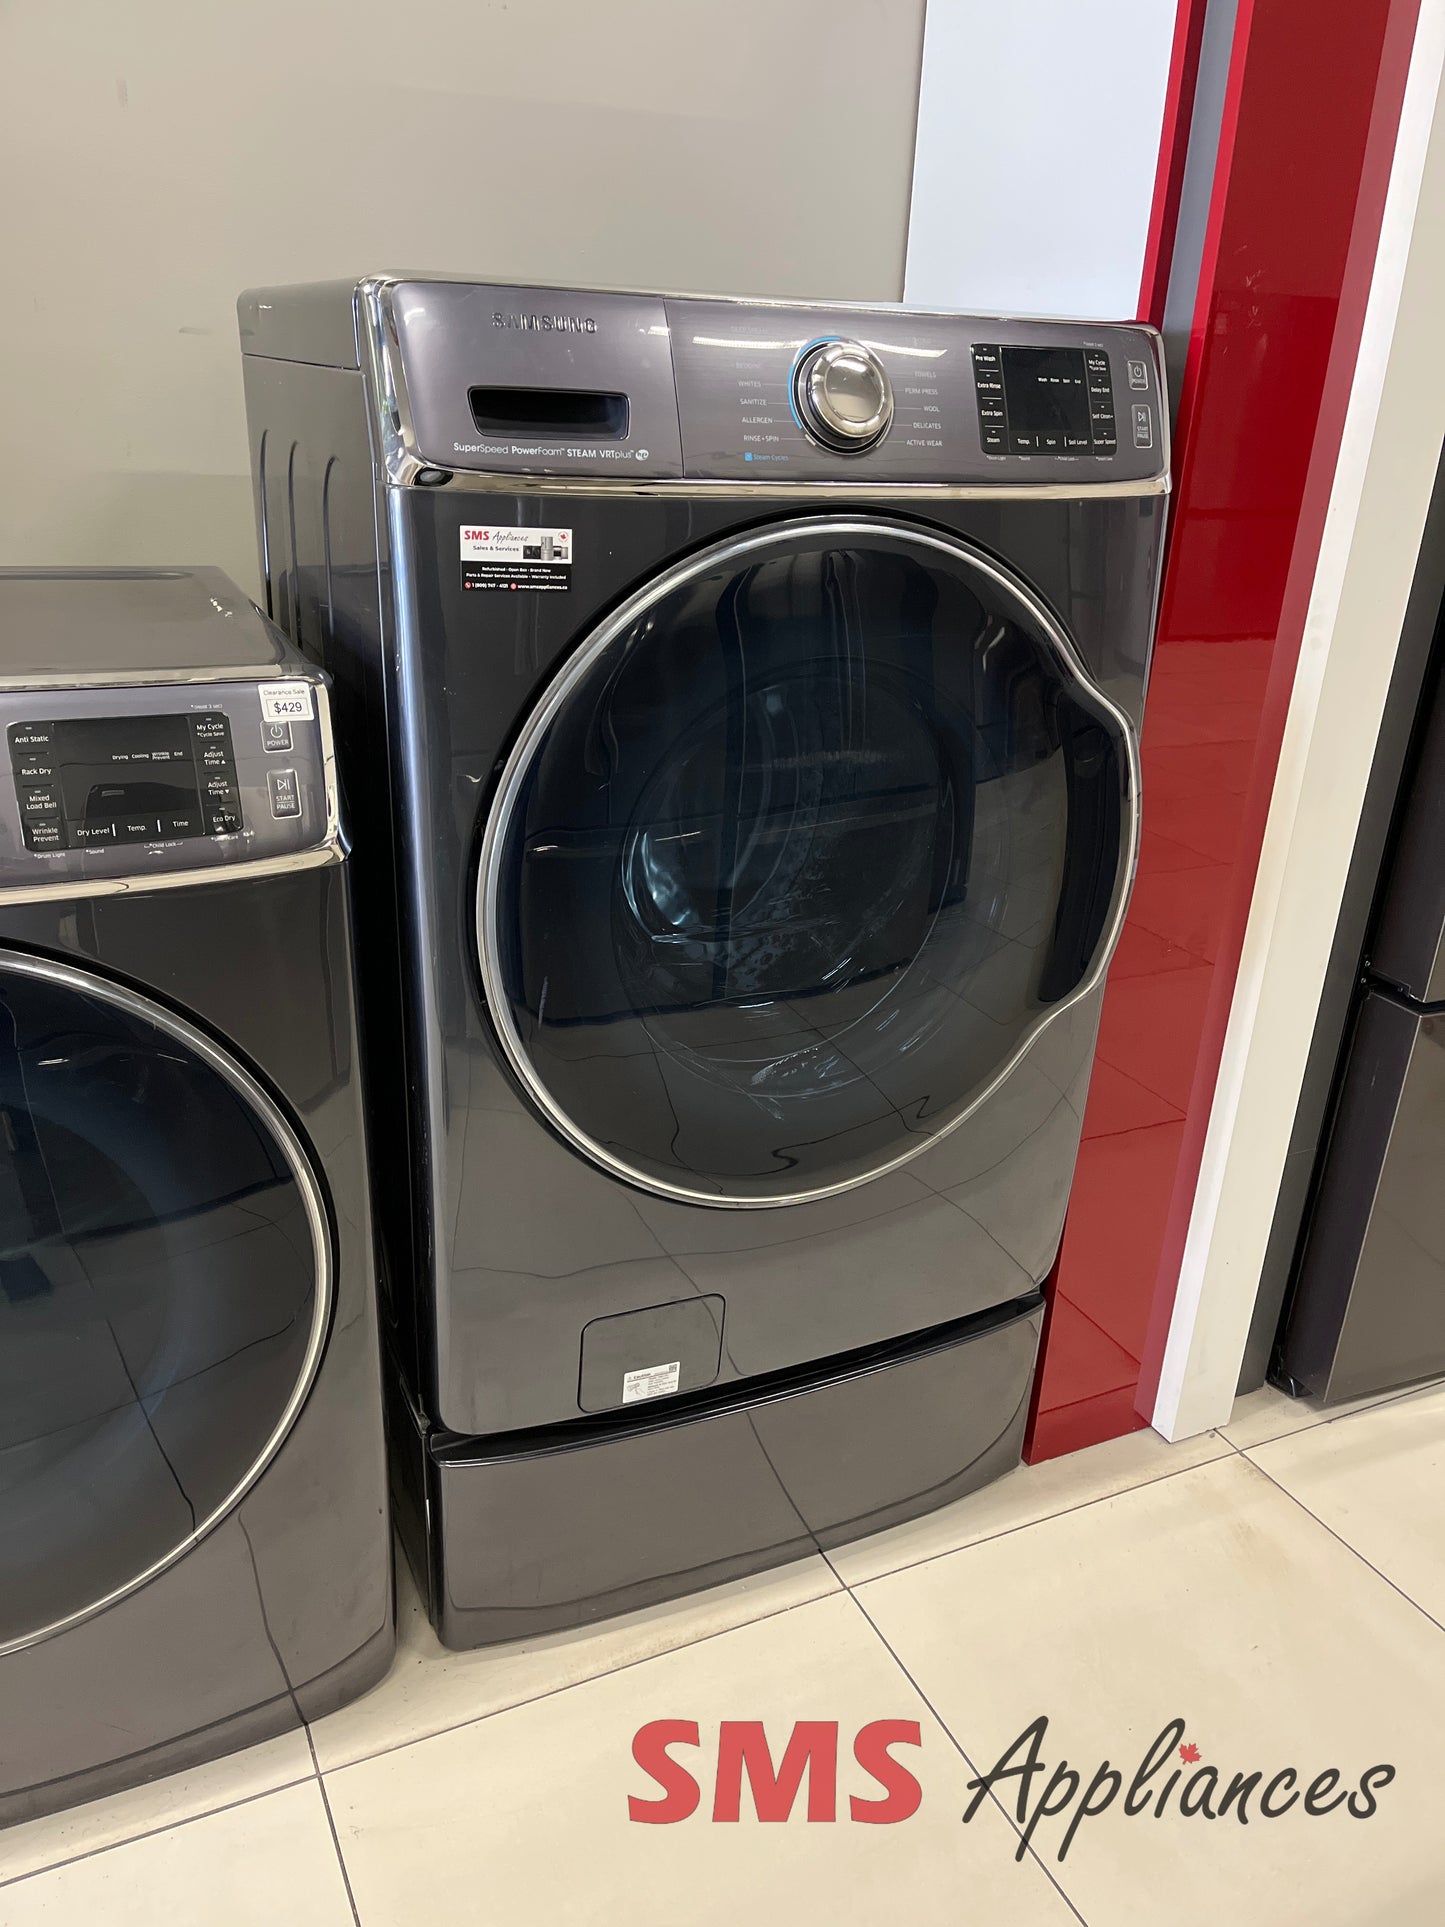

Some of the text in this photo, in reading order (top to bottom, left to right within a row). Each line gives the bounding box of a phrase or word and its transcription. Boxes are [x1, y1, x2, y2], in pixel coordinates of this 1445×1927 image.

[492, 312, 598, 333] SAMSUNG
[738, 380, 761, 388] WHITES
[740, 398, 767, 406] SANITIZE
[741, 416, 773, 424] ALLERGEN
[913, 421, 942, 429] DELICATES
[567, 448, 596, 458] STEAM
[464, 530, 529, 544] SMS Appliances
[274, 702, 302, 714] $429
[208, 723, 223, 731] Cycle
[30, 735, 49, 743] Static
[204, 751, 223, 759] Adjust
[39, 767, 51, 775] Dry
[208, 781, 228, 789] Adjust
[32, 827, 58, 835] Wrinkle
[77, 827, 110, 836] Dry Level
